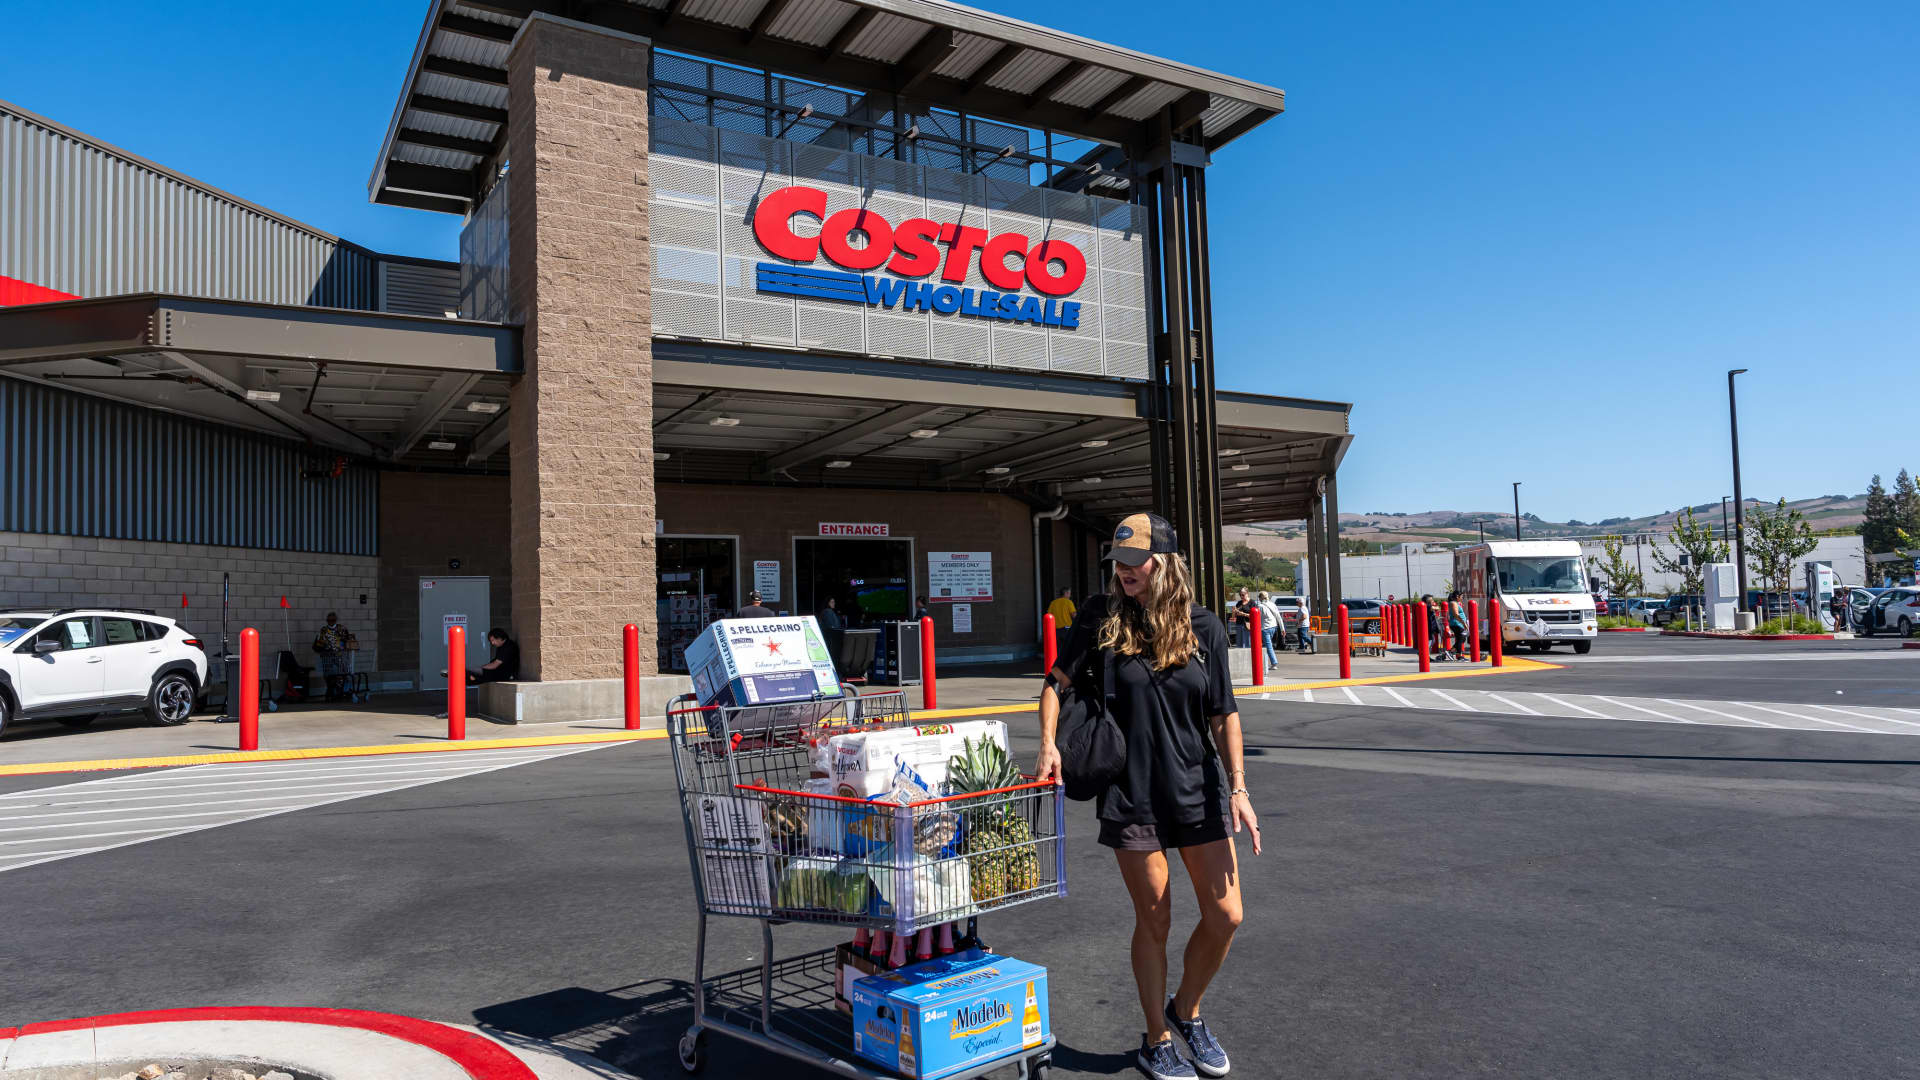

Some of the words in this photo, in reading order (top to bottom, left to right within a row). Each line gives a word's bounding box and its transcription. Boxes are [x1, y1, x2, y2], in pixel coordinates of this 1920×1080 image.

[754, 185, 1087, 296] COSTCO
[863, 275, 1081, 328] WHOLESALE
[821, 524, 887, 535] ENTRANCE
[730, 623, 801, 635] S.PELLEGRINO
[715, 624, 737, 675] S.PELLEGRINO
[854, 992, 864, 1004] 24
[924, 1011, 937, 1023] 24
[957, 1000, 1005, 1030] Modelo
[963, 1032, 1000, 1055] Especial
